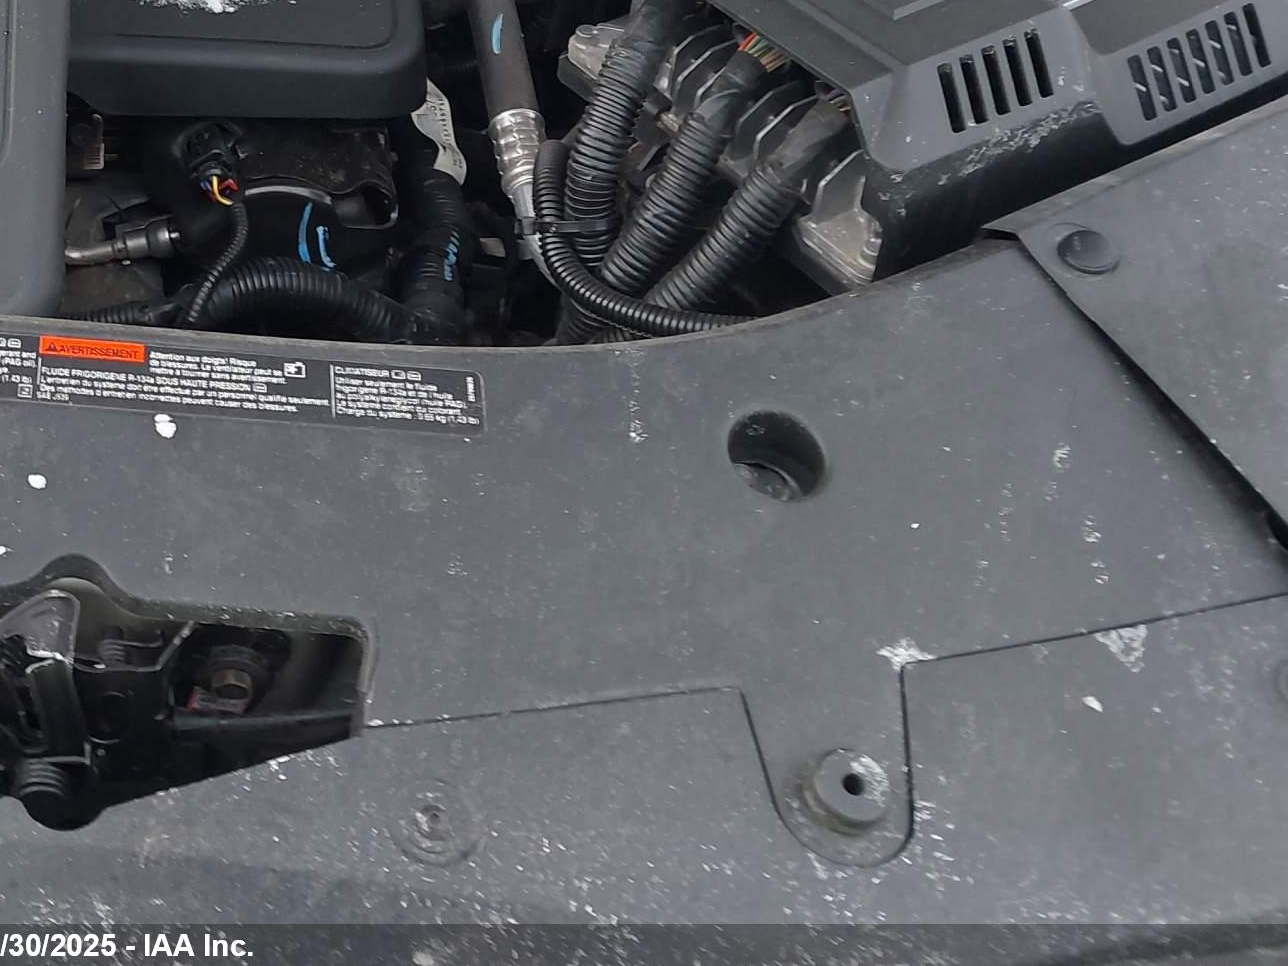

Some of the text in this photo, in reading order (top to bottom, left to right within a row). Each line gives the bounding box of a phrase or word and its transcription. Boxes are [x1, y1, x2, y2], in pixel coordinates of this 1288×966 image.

[22, 351, 37, 359] and
[59, 345, 139, 359] AVERTISSEMENT
[150, 351, 184, 362] Attention
[185, 355, 200, 363] aux
[229, 357, 257, 367] Risque
[149, 359, 159, 367] de
[201, 363, 211, 371] Le
[212, 365, 253, 374] ventilateur
[254, 368, 272, 377] peut
[334, 366, 390, 377] CLIMATISSEUR
[42, 366, 70, 376] FLUIDE
[128, 373, 154, 384] R-134a
[155, 376, 179, 386] SOUS
[179, 378, 208, 388] HAUTE
[209, 380, 251, 391] PRESSION
[211, 372, 230, 380] sans
[40, 384, 55, 392] Des
[214, 399, 241, 408] causer
[242, 401, 257, 409] des
[336, 407, 365, 417] Charge
